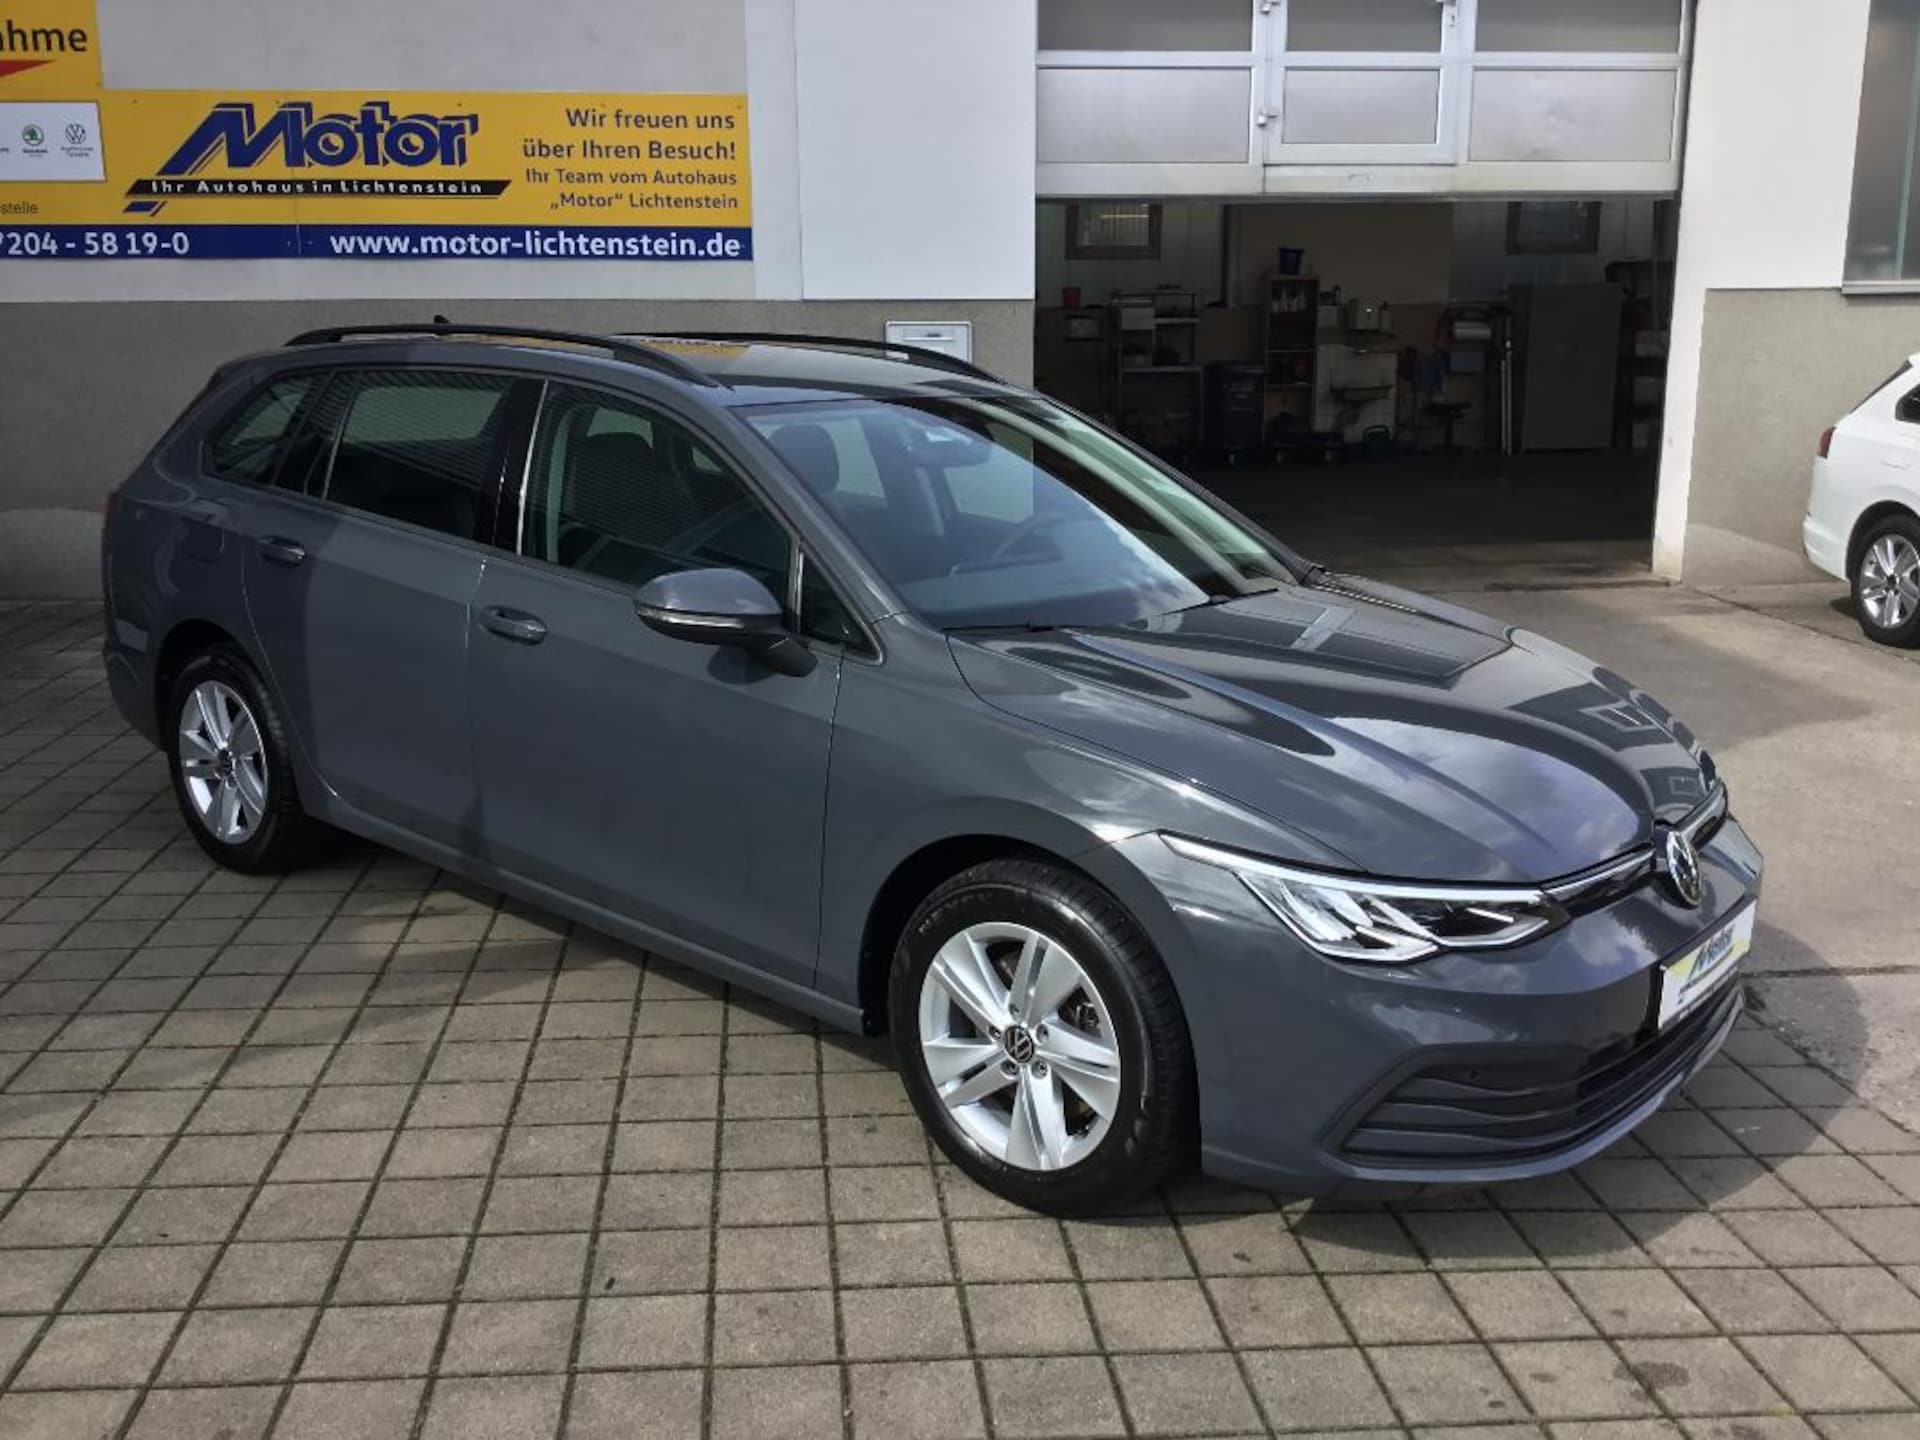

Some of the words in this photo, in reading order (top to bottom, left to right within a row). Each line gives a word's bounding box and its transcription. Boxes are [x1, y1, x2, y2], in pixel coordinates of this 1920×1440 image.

[0, 18, 88, 53] hme
[566, 108, 607, 128] Wir
[614, 109, 688, 129] freuen
[696, 114, 736, 129] uns
[155, 101, 479, 177] Motor
[522, 138, 575, 159] über
[582, 140, 641, 160] Ihren
[648, 141, 737, 161] Besuch!
[151, 181, 185, 194] Ihr
[196, 181, 305, 194] Autohaus
[312, 180, 333, 194] in
[340, 181, 482, 194] Lichtenstein
[526, 168, 550, 184] Ihr
[555, 168, 604, 184] Team
[609, 172, 647, 185] vom
[652, 170, 738, 186] Autohaus
[629, 194, 739, 209] Lichtenstein
[330, 229, 742, 257] www.motor-lichtenstein.de
